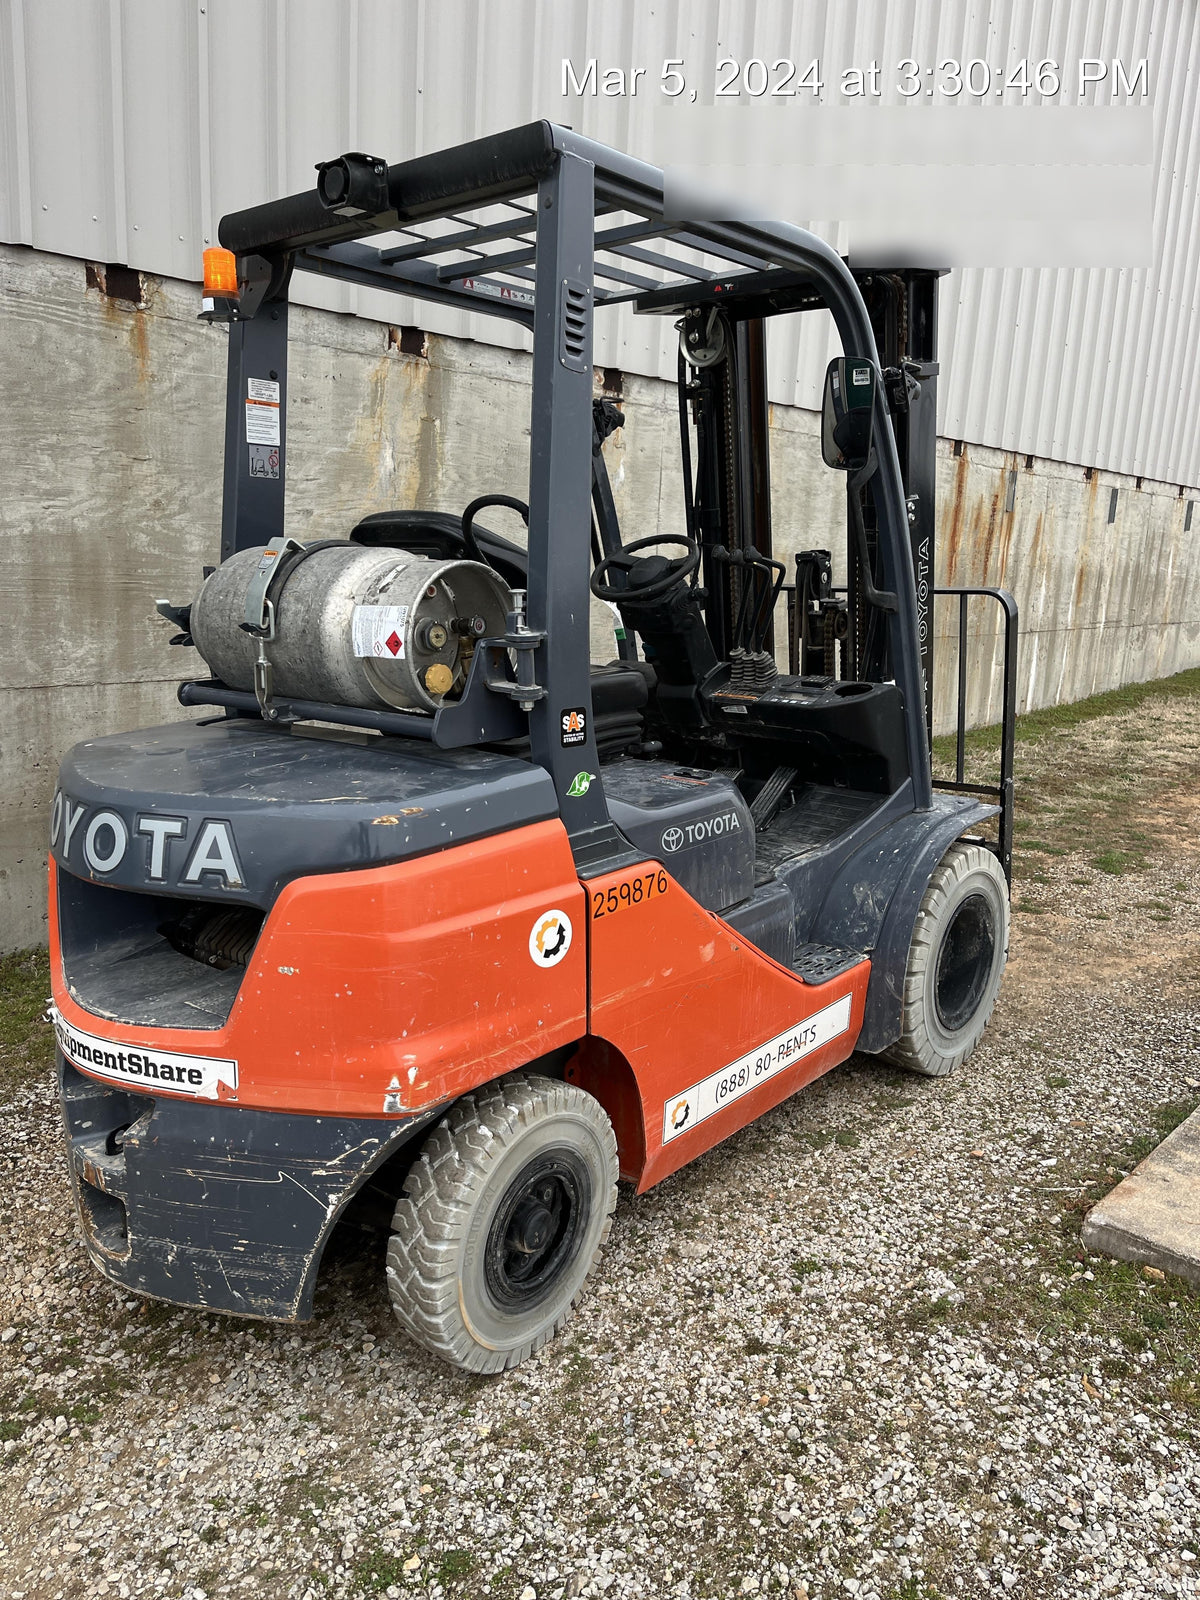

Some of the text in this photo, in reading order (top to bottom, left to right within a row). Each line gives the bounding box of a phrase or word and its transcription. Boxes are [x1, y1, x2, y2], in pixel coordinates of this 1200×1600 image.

[562, 711, 585, 733] SAS
[51, 791, 243, 884] OYOTA
[685, 812, 740, 843] TOYOTA
[593, 869, 668, 918] 259876
[56, 1025, 204, 1086] quipmentShare
[715, 1024, 817, 1105] (888) 80-RENTS
